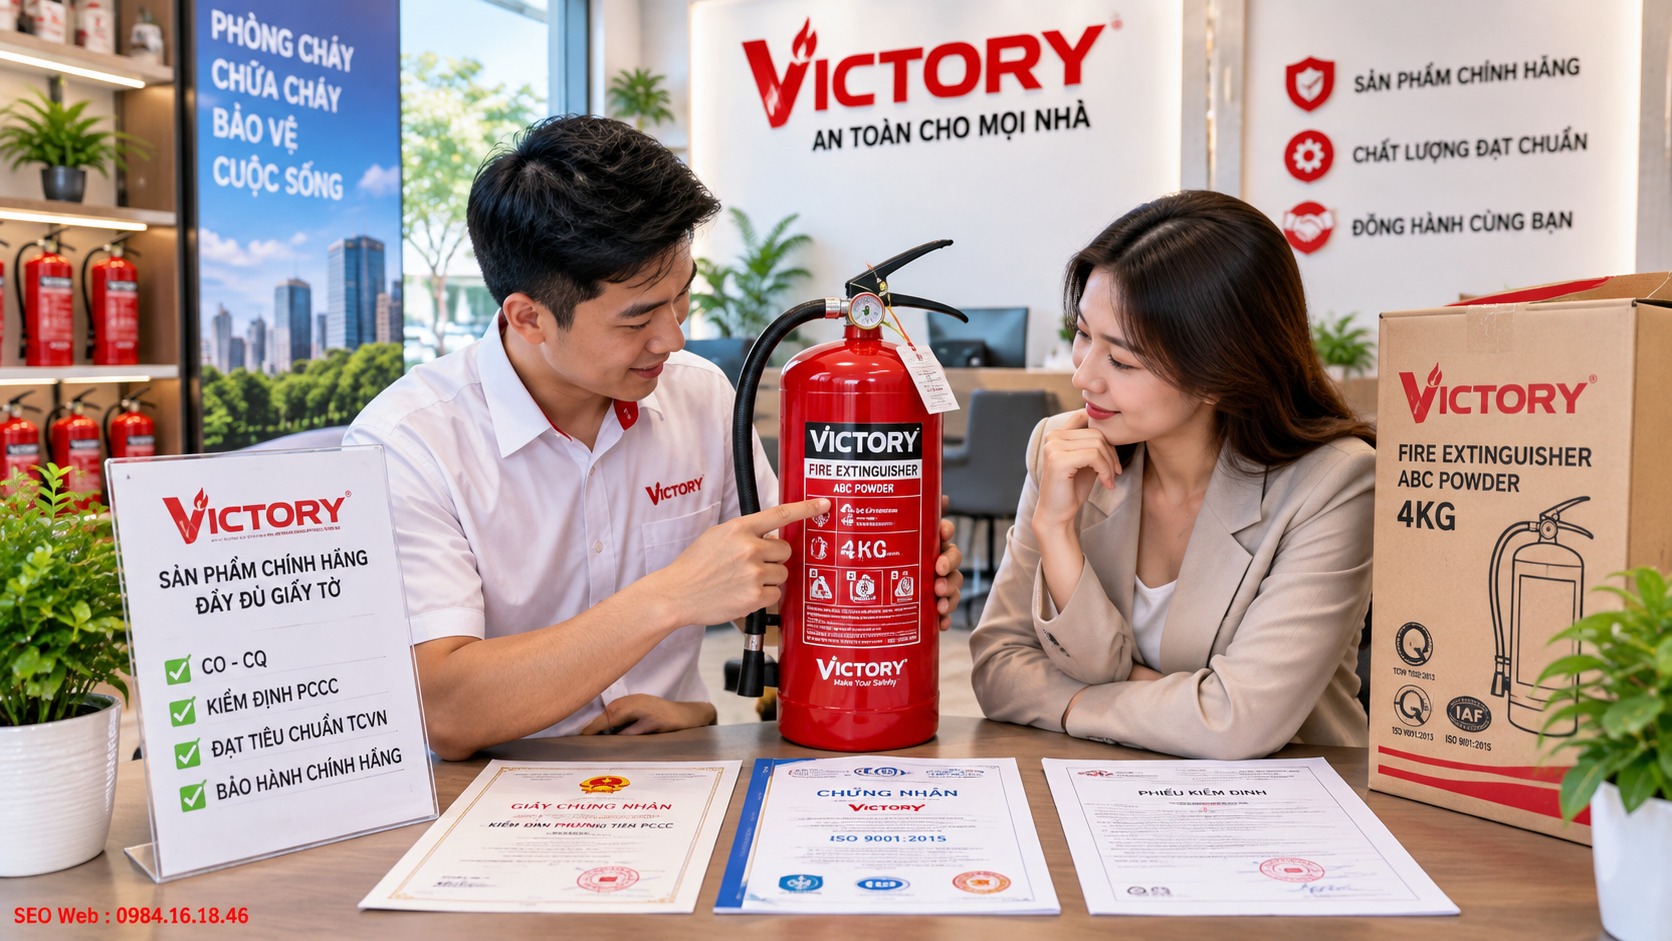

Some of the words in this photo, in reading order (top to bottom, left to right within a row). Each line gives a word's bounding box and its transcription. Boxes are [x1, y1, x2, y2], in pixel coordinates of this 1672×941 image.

[211, 9, 293, 58] PHÒNG
[742, 16, 1106, 129] VICTORY
[812, 129, 843, 152] AN
[850, 119, 911, 147] TOÀN
[919, 116, 970, 141] CHO
[979, 111, 1026, 141] MỌI
[1035, 100, 1091, 131] NHÀ
[1398, 361, 1588, 424] VICTORY
[810, 425, 919, 453] VICTORY
[809, 463, 832, 476] FIRE
[836, 464, 918, 477] EXTINGUISHER
[1398, 444, 1436, 463] FIRE
[1442, 445, 1592, 467] EXTINGUISHER
[645, 477, 703, 506] VICTORY
[833, 483, 852, 493] ABC
[855, 484, 894, 493] POWDER
[1398, 469, 1434, 488] ABC
[1439, 471, 1520, 493] POWDER
[162, 487, 345, 545] VICTORY
[1397, 500, 1456, 531] 4KG
[159, 564, 198, 589] SẢN
[261, 553, 316, 577] CHÍNH
[271, 578, 312, 605] GIẤY
[317, 576, 342, 599] TỜ
[202, 655, 226, 675] CO
[243, 650, 267, 668] CQ
[816, 655, 906, 680] VICTORY
[252, 685, 293, 709] ĐỊNH
[297, 678, 339, 700] PCCC
[1455, 705, 1483, 723] IAF
[211, 736, 244, 759] ĐẠT
[248, 726, 284, 750] TIÊU
[347, 709, 388, 731] TCVN
[1445, 734, 1457, 744] ISO
[256, 767, 302, 792] HÀNH
[306, 757, 355, 781] CHÍNH
[848, 804, 926, 812] VICTORY
[830, 835, 858, 843] ISO
[864, 835, 947, 843] 9001:2015
